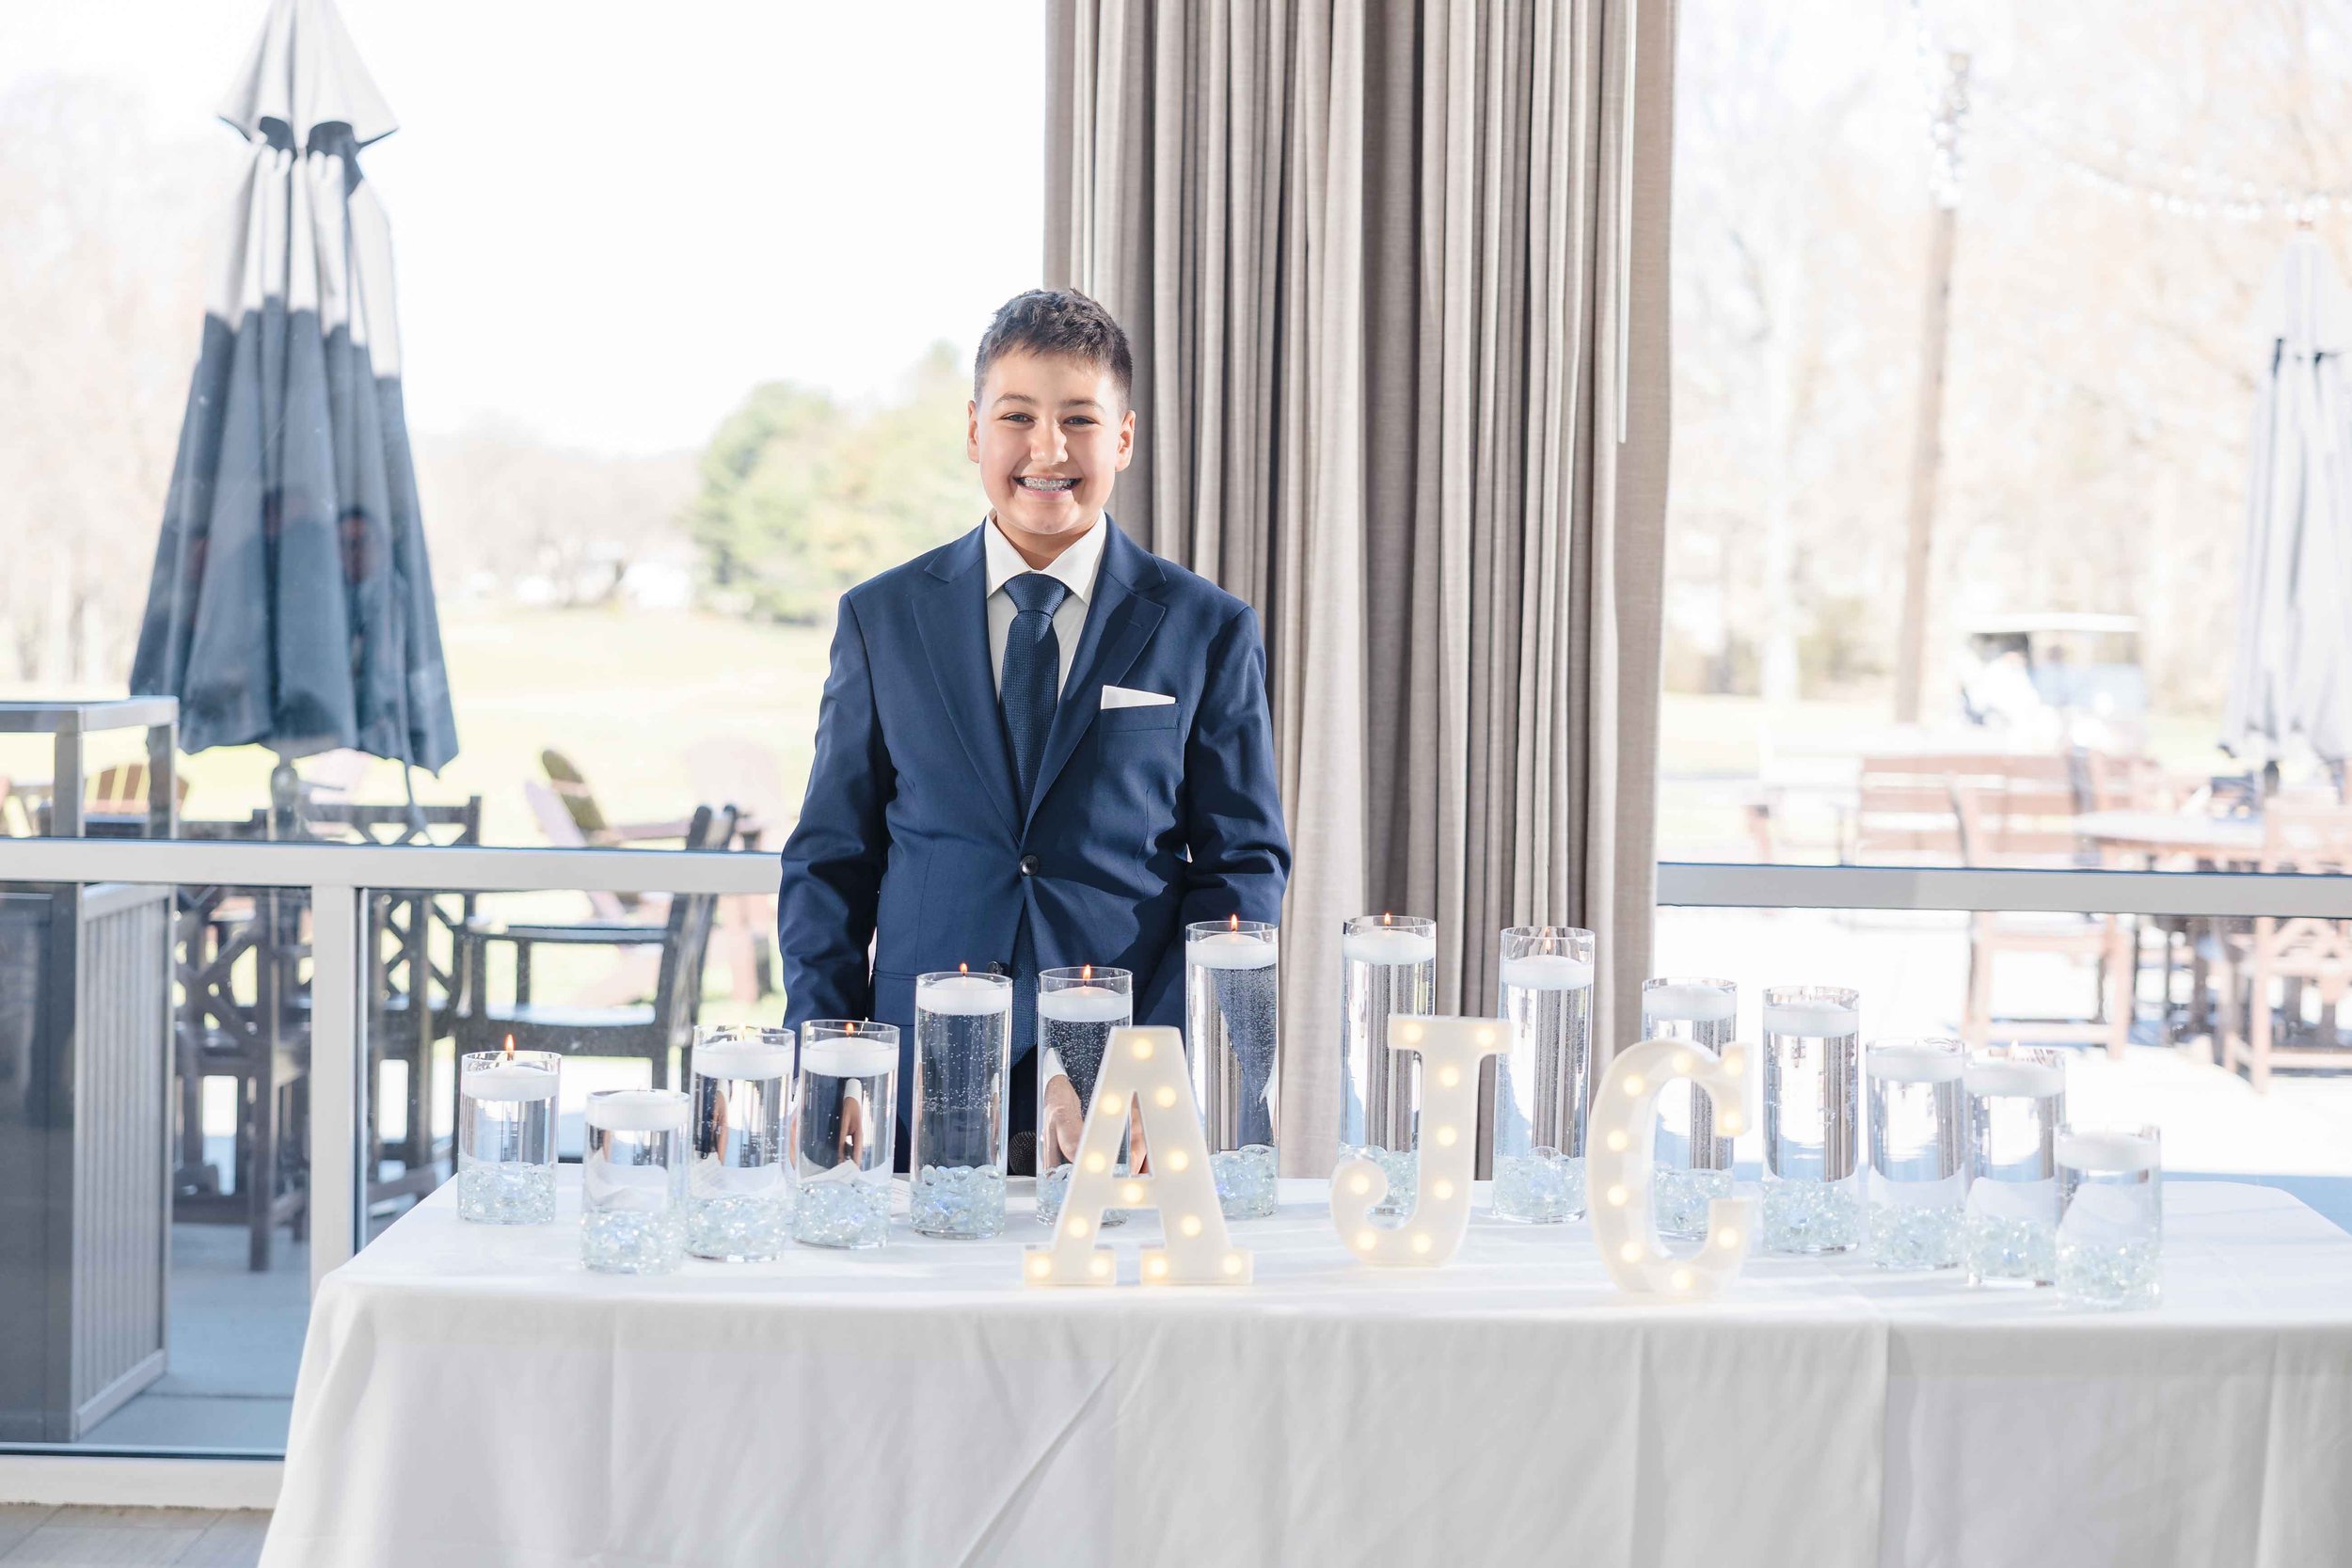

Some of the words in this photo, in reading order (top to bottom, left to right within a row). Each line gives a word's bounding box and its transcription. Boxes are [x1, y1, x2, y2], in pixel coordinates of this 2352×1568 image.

[1024, 1025, 1254, 1286] A
[1329, 1014, 1512, 1268] J
[1585, 1038, 1755, 1298] C
